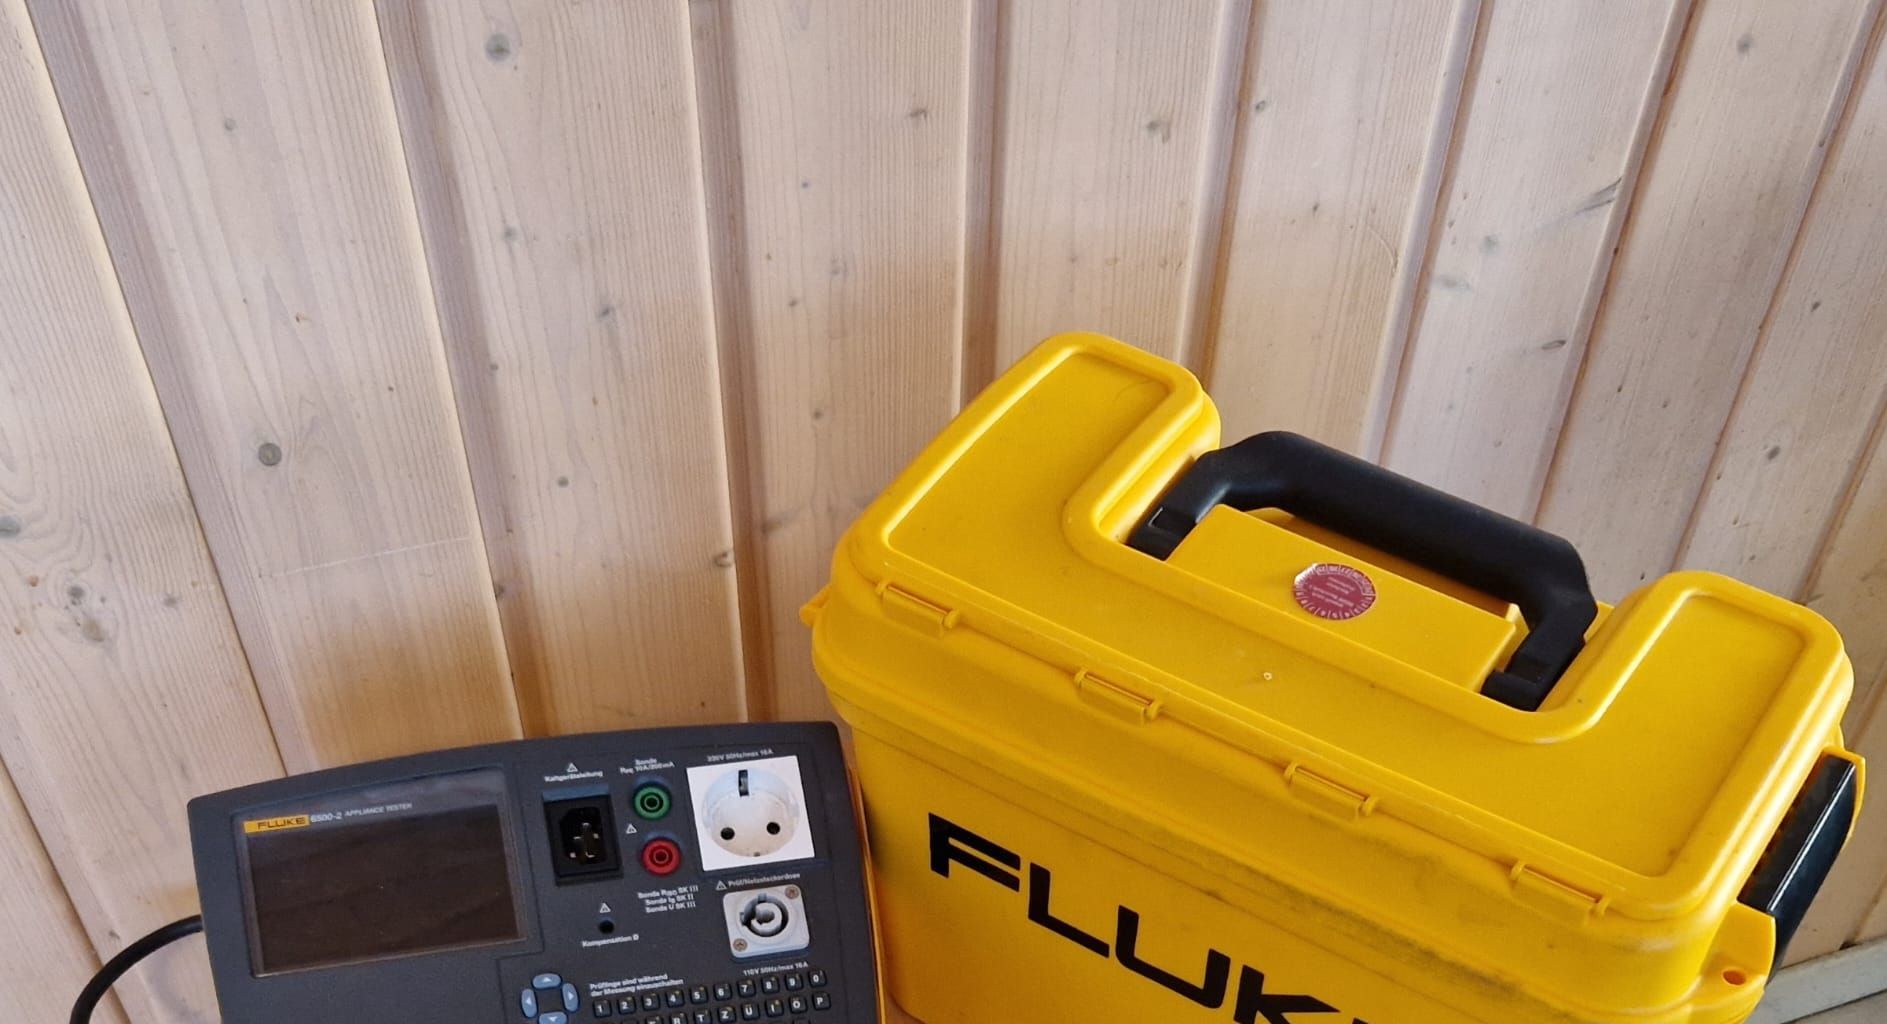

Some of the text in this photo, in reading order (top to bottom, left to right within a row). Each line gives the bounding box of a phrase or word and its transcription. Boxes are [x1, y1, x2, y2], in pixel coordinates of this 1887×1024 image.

[310, 803, 413, 822] 6500-2 APPLIANCE TESTER
[257, 818, 306, 830] FLUKE
[582, 936, 632, 948] Kompensation
[590, 973, 669, 990] Prüflinge sind während
[590, 990, 603, 998] der
[604, 986, 636, 995] Messung
[622, 1002, 628, 1010] 2
[645, 998, 652, 1006] 3
[670, 994, 676, 1002] 4
[694, 992, 700, 1000] 5
[718, 988, 724, 996] 6
[742, 984, 748, 992] 7
[766, 982, 772, 990] 8
[789, 978, 796, 986] 9
[812, 974, 819, 983] 0
[696, 1014, 704, 1022] T
[722, 1010, 729, 1020] Z
[816, 997, 824, 1006] P
